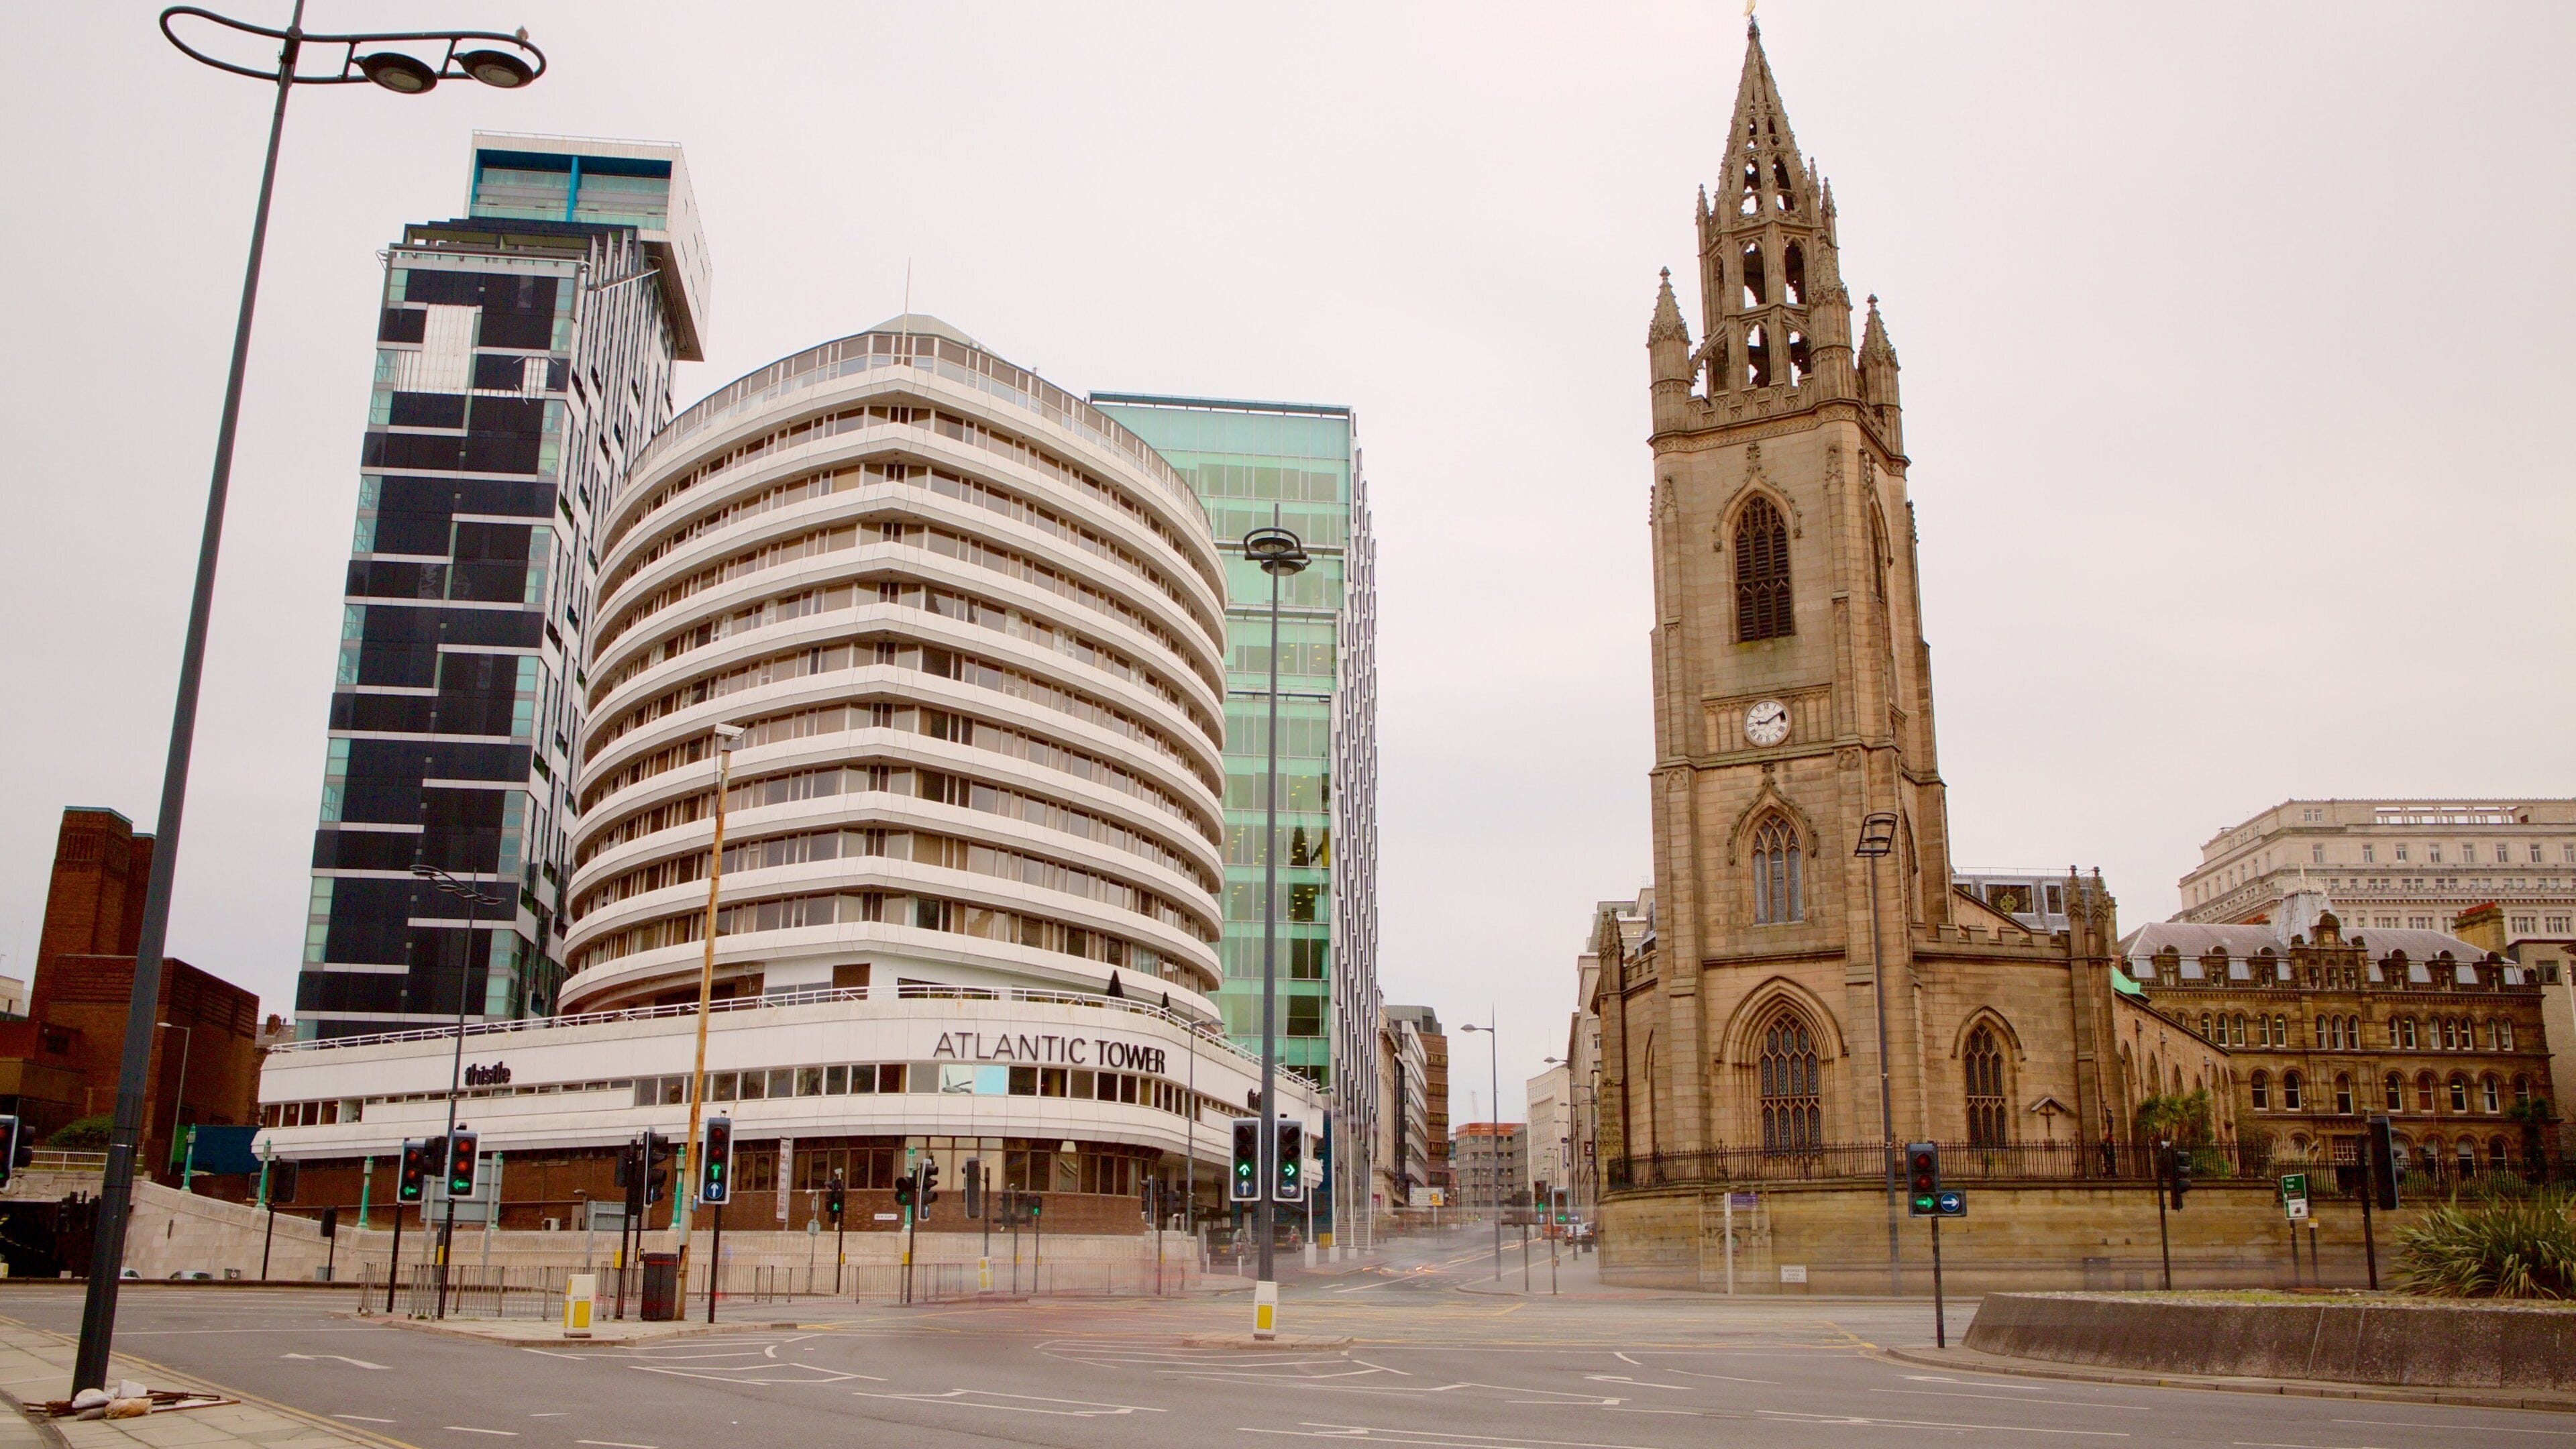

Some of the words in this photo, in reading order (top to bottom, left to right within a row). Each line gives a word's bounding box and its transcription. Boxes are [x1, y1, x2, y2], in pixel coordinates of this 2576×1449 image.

[932, 1031, 1086, 1064] ATLANTIC
[1094, 1039, 1165, 1074] TOWER
[465, 1061, 511, 1086] thistle
